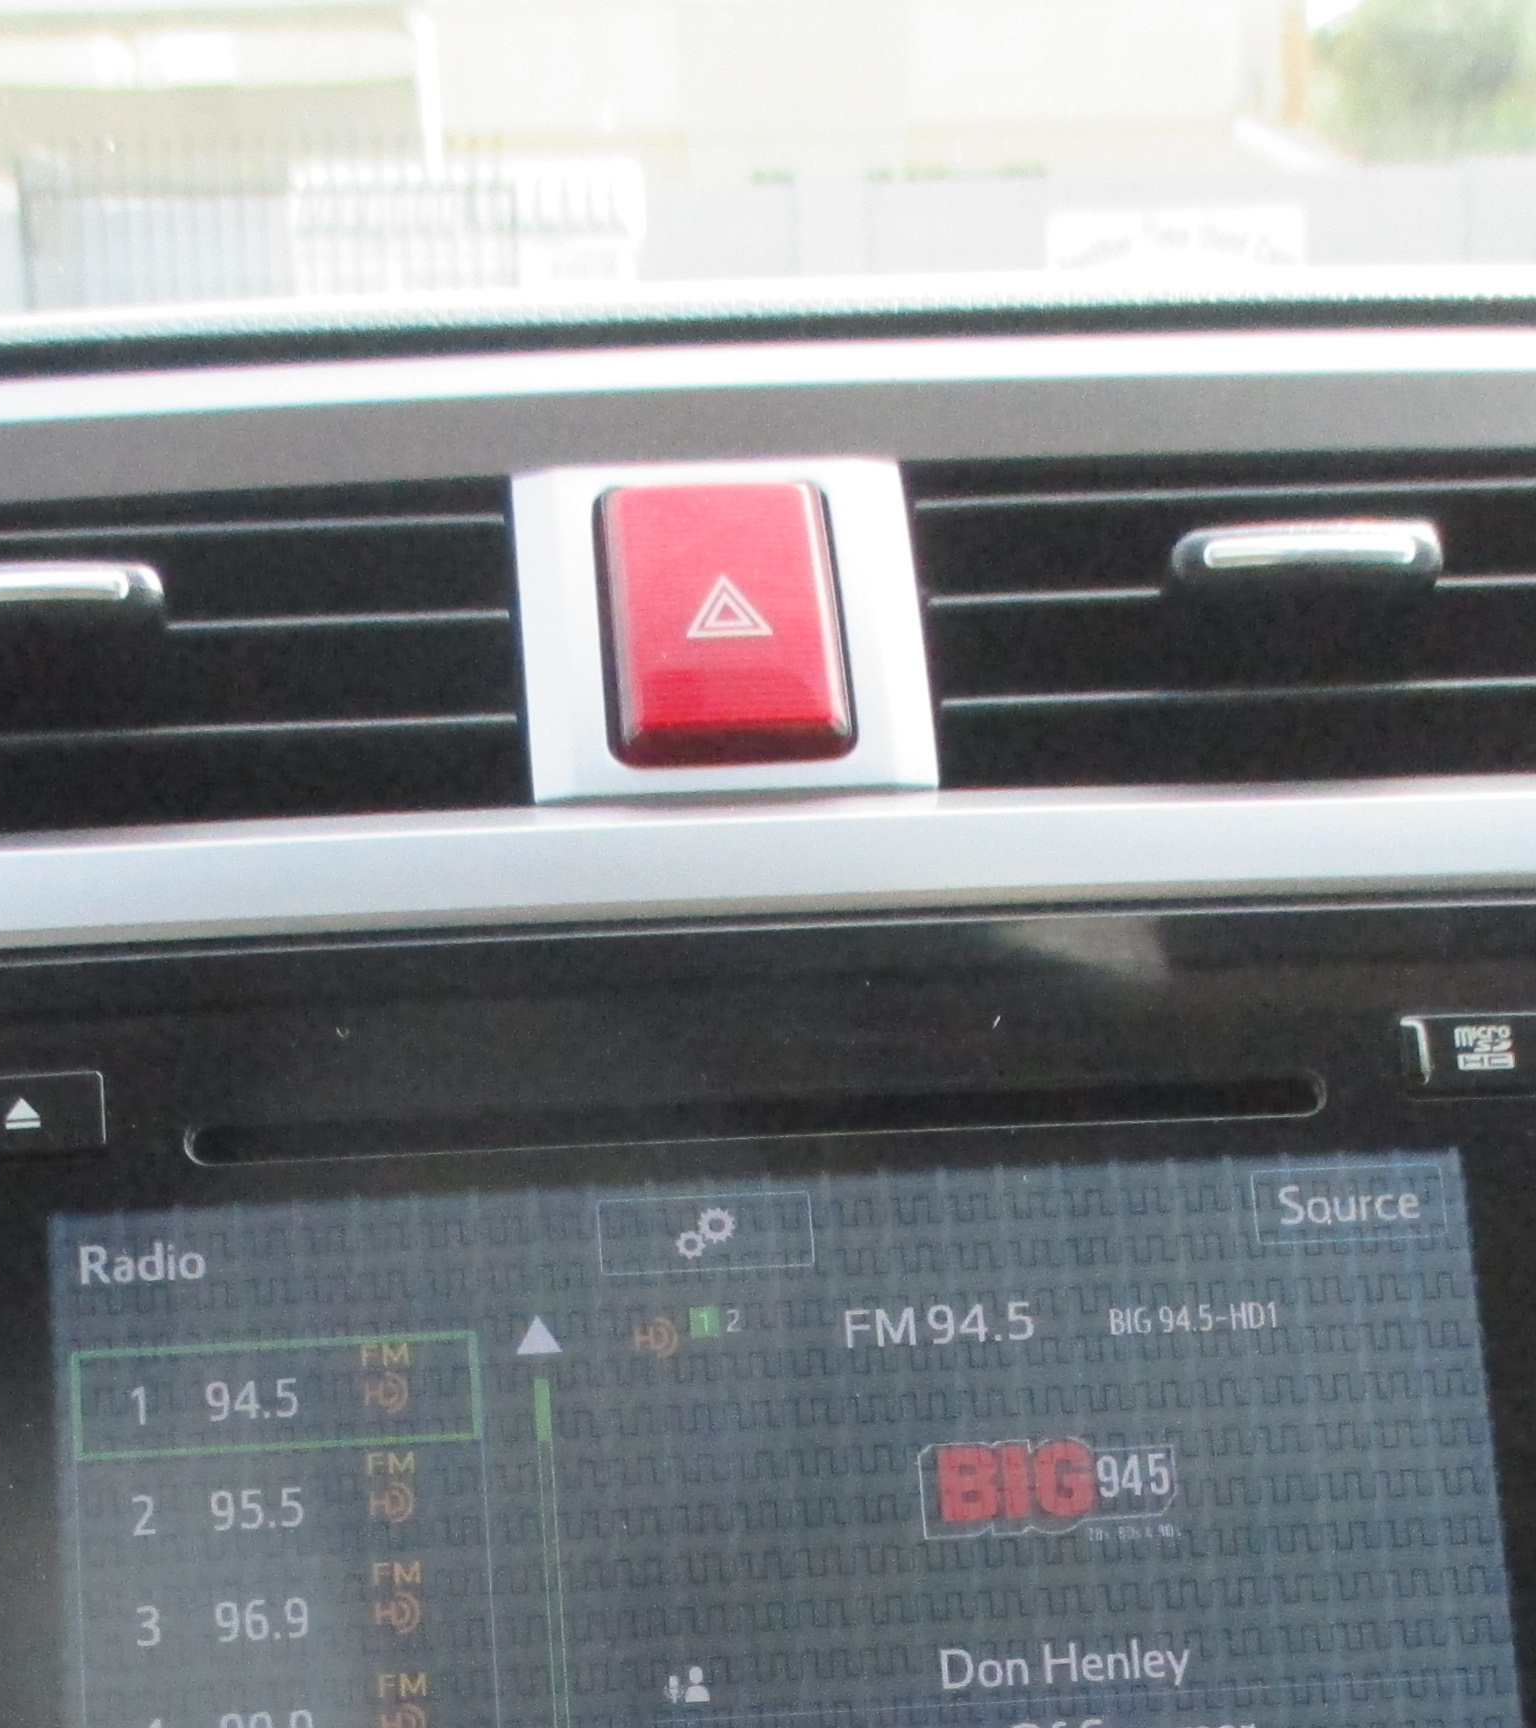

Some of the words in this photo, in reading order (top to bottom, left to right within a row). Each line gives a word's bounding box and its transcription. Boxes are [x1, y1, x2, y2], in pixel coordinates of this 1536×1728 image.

[1279, 1186, 1421, 1228] Source
[78, 1243, 207, 1285] Radio
[1108, 1307, 1152, 1336] BIG
[361, 1341, 410, 1368] FM
[129, 1386, 151, 1425] 1
[205, 1378, 300, 1423] 94.5
[367, 1451, 416, 1476] FM
[938, 1441, 1095, 1523] BIG
[131, 1496, 158, 1537] 2
[210, 1486, 306, 1532] 95.5
[372, 1561, 422, 1586] FM
[136, 1604, 162, 1647] 3
[214, 1597, 310, 1643] 96.9
[378, 1671, 428, 1698] FM
[940, 1648, 1032, 1691] Don
[1041, 1639, 1191, 1696] Henley
